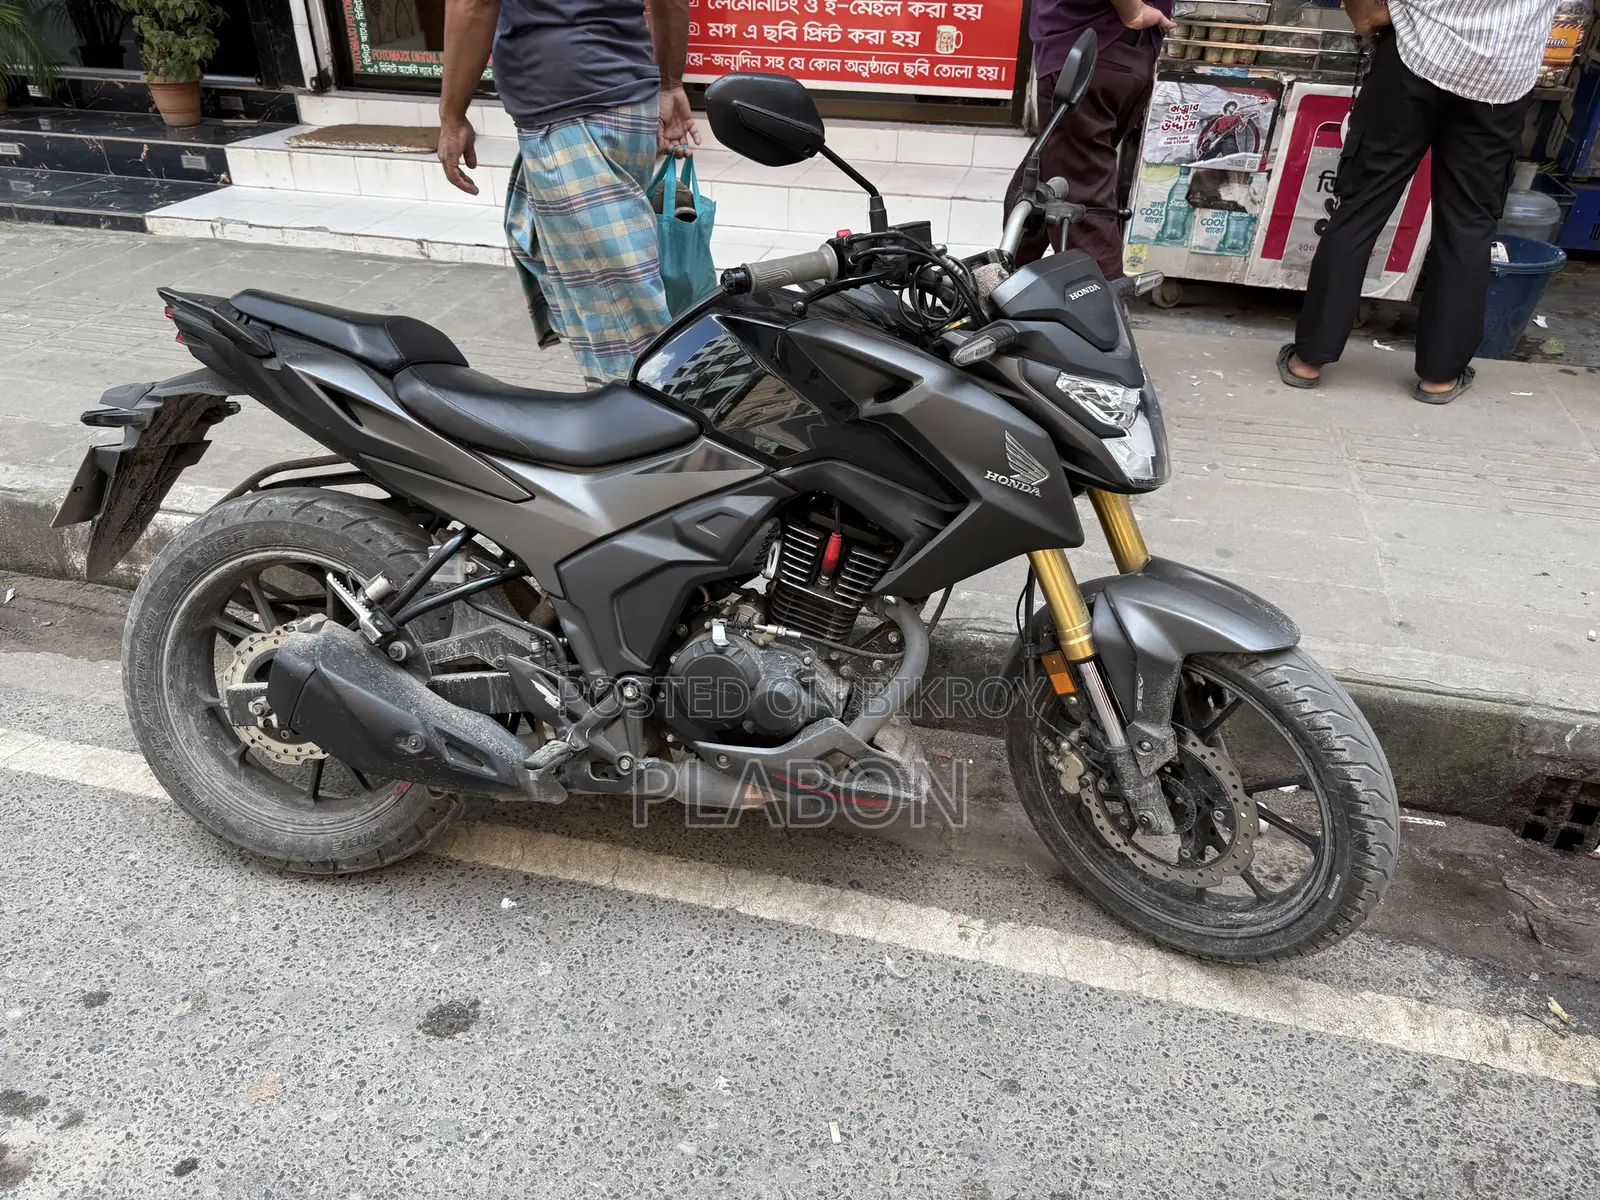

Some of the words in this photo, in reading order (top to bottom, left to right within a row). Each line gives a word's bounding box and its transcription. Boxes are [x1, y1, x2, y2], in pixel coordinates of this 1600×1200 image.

[804, 0, 819, 13] ও
[908, 2, 947, 18] করা
[953, 4, 983, 21] হয়
[707, 23, 737, 38] মগ
[743, 24, 757, 39] এ
[763, 20, 798, 43] ছবি
[803, 21, 843, 43] প্রিন্ট
[848, 28, 886, 45] করা
[891, 31, 921, 48] হয়
[764, 56, 785, 70] সহ
[788, 57, 805, 71] যে
[808, 59, 841, 72] কোন
[845, 56, 900, 78] অনুষ্ঠানে
[903, 58, 930, 78] ছবি
[934, 64, 973, 79] তোলা
[1140, 208, 1164, 216] COOL
[1200, 218, 1225, 226] COOL
[1069, 284, 1101, 301] HONDA
[984, 470, 1042, 498] HONDA
